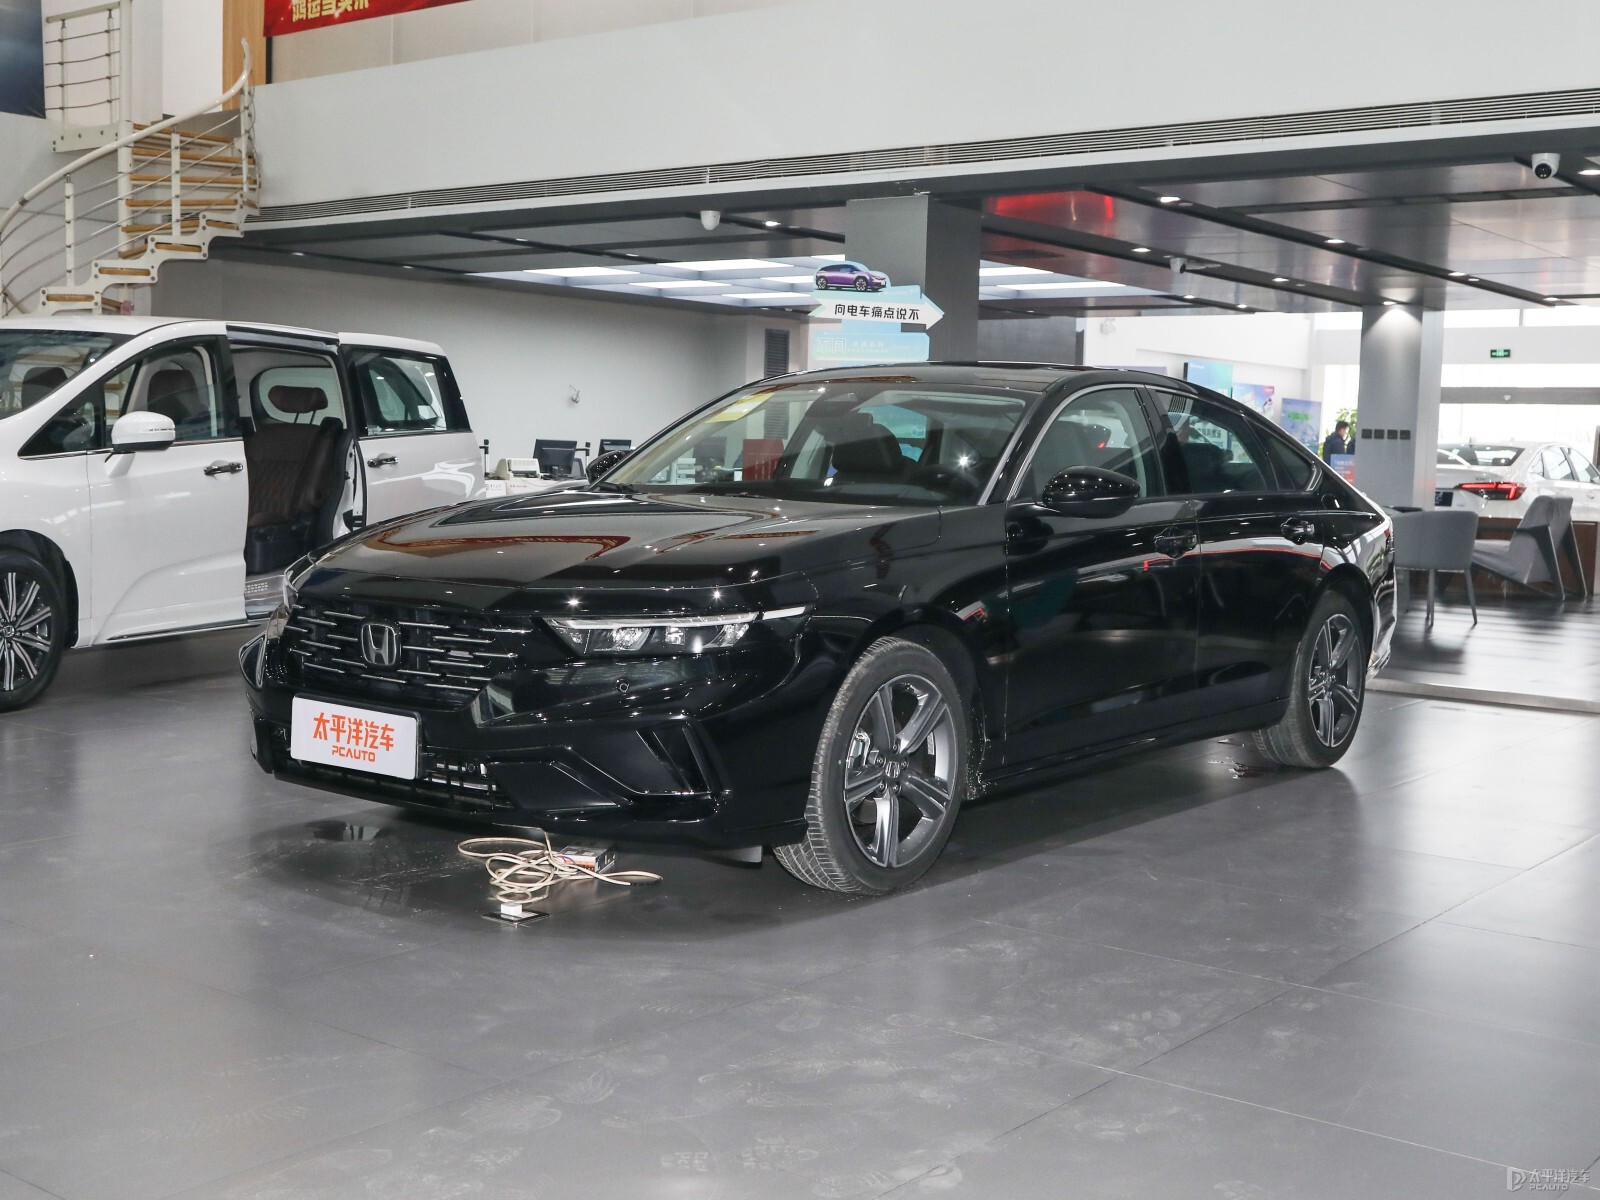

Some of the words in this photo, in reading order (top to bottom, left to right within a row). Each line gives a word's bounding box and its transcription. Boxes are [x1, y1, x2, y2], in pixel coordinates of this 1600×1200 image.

[834, 303, 920, 321] 向电车痛点说不
[313, 712, 395, 752] 太平洋汽车
[332, 745, 376, 762] PCAUTO
